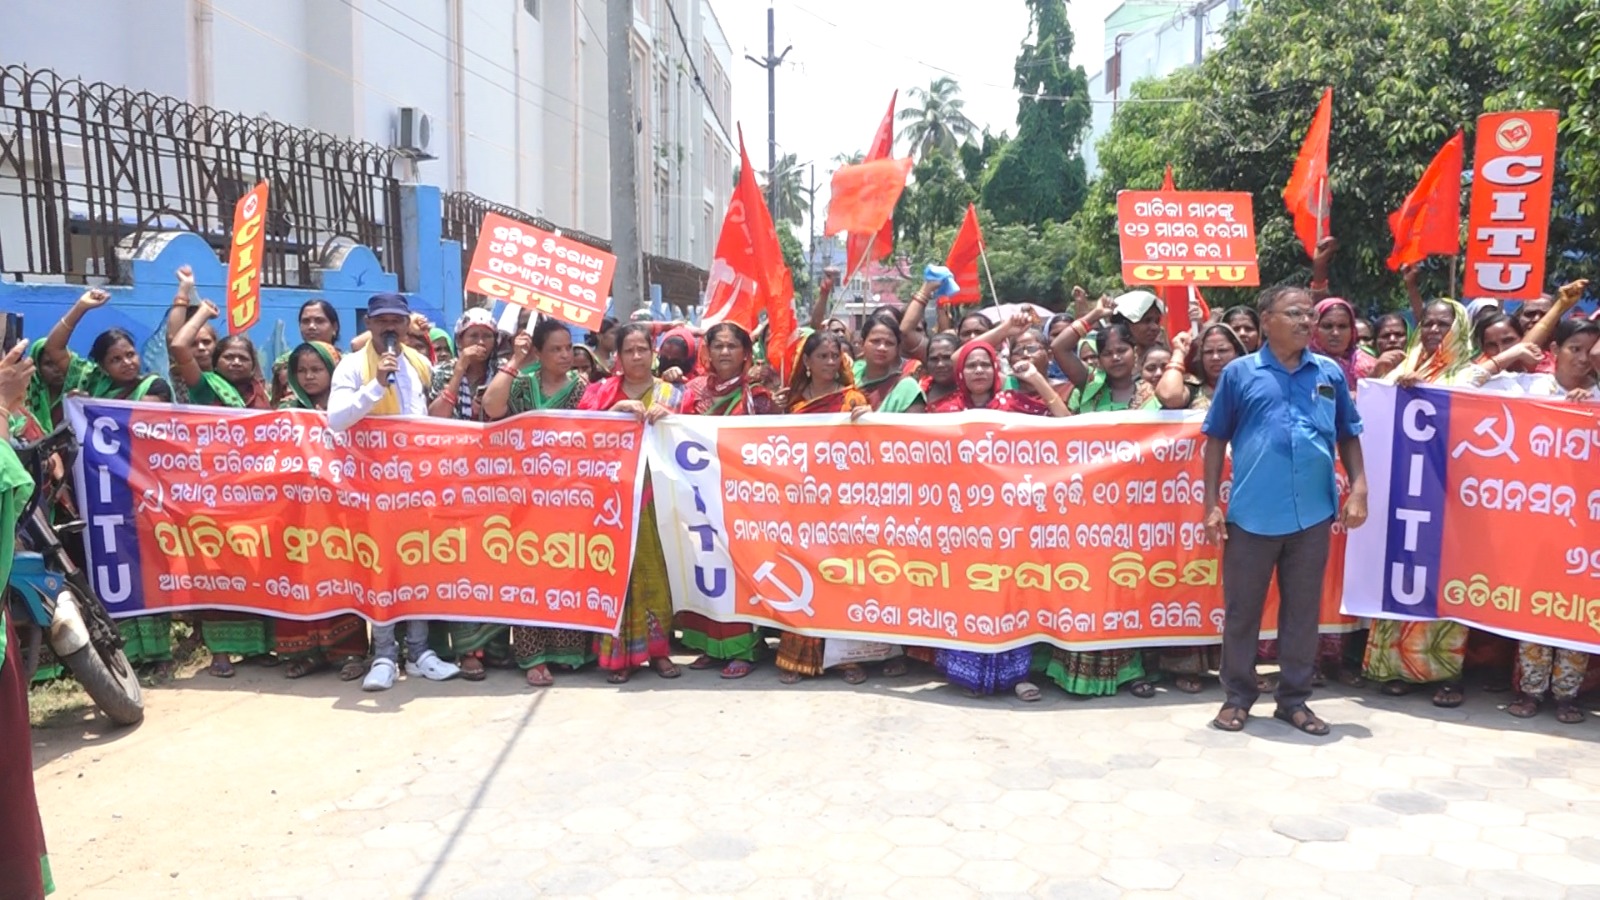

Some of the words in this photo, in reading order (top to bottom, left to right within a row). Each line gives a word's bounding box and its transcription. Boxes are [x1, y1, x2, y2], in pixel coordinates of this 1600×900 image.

[1134, 198, 1182, 217] ପାଚିକା
[1188, 203, 1236, 222] ମାନଙ୍କୁ
[1474, 155, 1543, 291] CITU
[1124, 223, 1149, 237] ୧୨
[1155, 222, 1199, 238] ମାସର
[1204, 223, 1248, 238] ଦରମା
[1145, 242, 1188, 260] ପ୍ରଦାନ
[1194, 243, 1221, 258] କର
[232, 214, 261, 327] CITU
[1133, 265, 1246, 281] CITU
[478, 277, 592, 323] CITU
[568, 283, 597, 303] କର
[393, 432, 408, 447] ଓ
[531, 429, 587, 449] ଅବସର
[593, 432, 635, 450] ସମୟ
[879, 440, 952, 465] ସରକାରୀ
[957, 431, 1059, 466] କର୍ମଚାରୀର
[1151, 438, 1196, 462] ବୀମା
[419, 460, 432, 477] ୨
[522, 452, 571, 477] ପାଚିକା
[577, 459, 622, 482] ମାନଙ୍କୁ
[92, 416, 132, 604] CITU
[222, 484, 278, 503] ଭୋଜନ
[375, 490, 436, 511] କାମରେ
[442, 488, 456, 506] ନ
[461, 485, 527, 505] ଲଗାଇବା
[531, 487, 595, 508] ଦାବୀରେ
[725, 479, 780, 504] ଅବସର
[918, 483, 942, 506] ୬୦
[947, 482, 963, 514] ରୁ
[967, 484, 995, 507] ୬୨
[1001, 475, 1047, 512] ବର୍ଷକୁ
[1092, 482, 1120, 505] ୧୦
[1126, 480, 1157, 505] ମାସ
[1390, 399, 1437, 606] CITU
[1459, 476, 1577, 528] ପେନସନ୍
[675, 441, 727, 598] CITU
[936, 524, 993, 553] ମୁତାବକ
[999, 526, 1024, 550] ୨୮
[1029, 523, 1070, 549] ମାସର
[1076, 523, 1133, 549] ବକେୟା
[154, 515, 273, 559] ପାଚିକା
[282, 524, 383, 574] ସଂଘର
[396, 525, 468, 567] ଗଣ
[481, 514, 617, 576] ବିକ୍ଷୋଭ
[818, 548, 950, 589] ପାଚିକା
[966, 562, 1092, 594] ସଂଘର
[158, 573, 247, 592] ଆୟୋଜକ
[366, 584, 430, 608] ଭୋଜନ
[436, 578, 494, 602] ପାଚିକା
[545, 588, 581, 611] ପୁରୀ
[964, 610, 1030, 637] ଭୋଜନ
[1037, 607, 1096, 633] ପାଚିକା
[1150, 601, 1202, 629] ପିପିଲି
